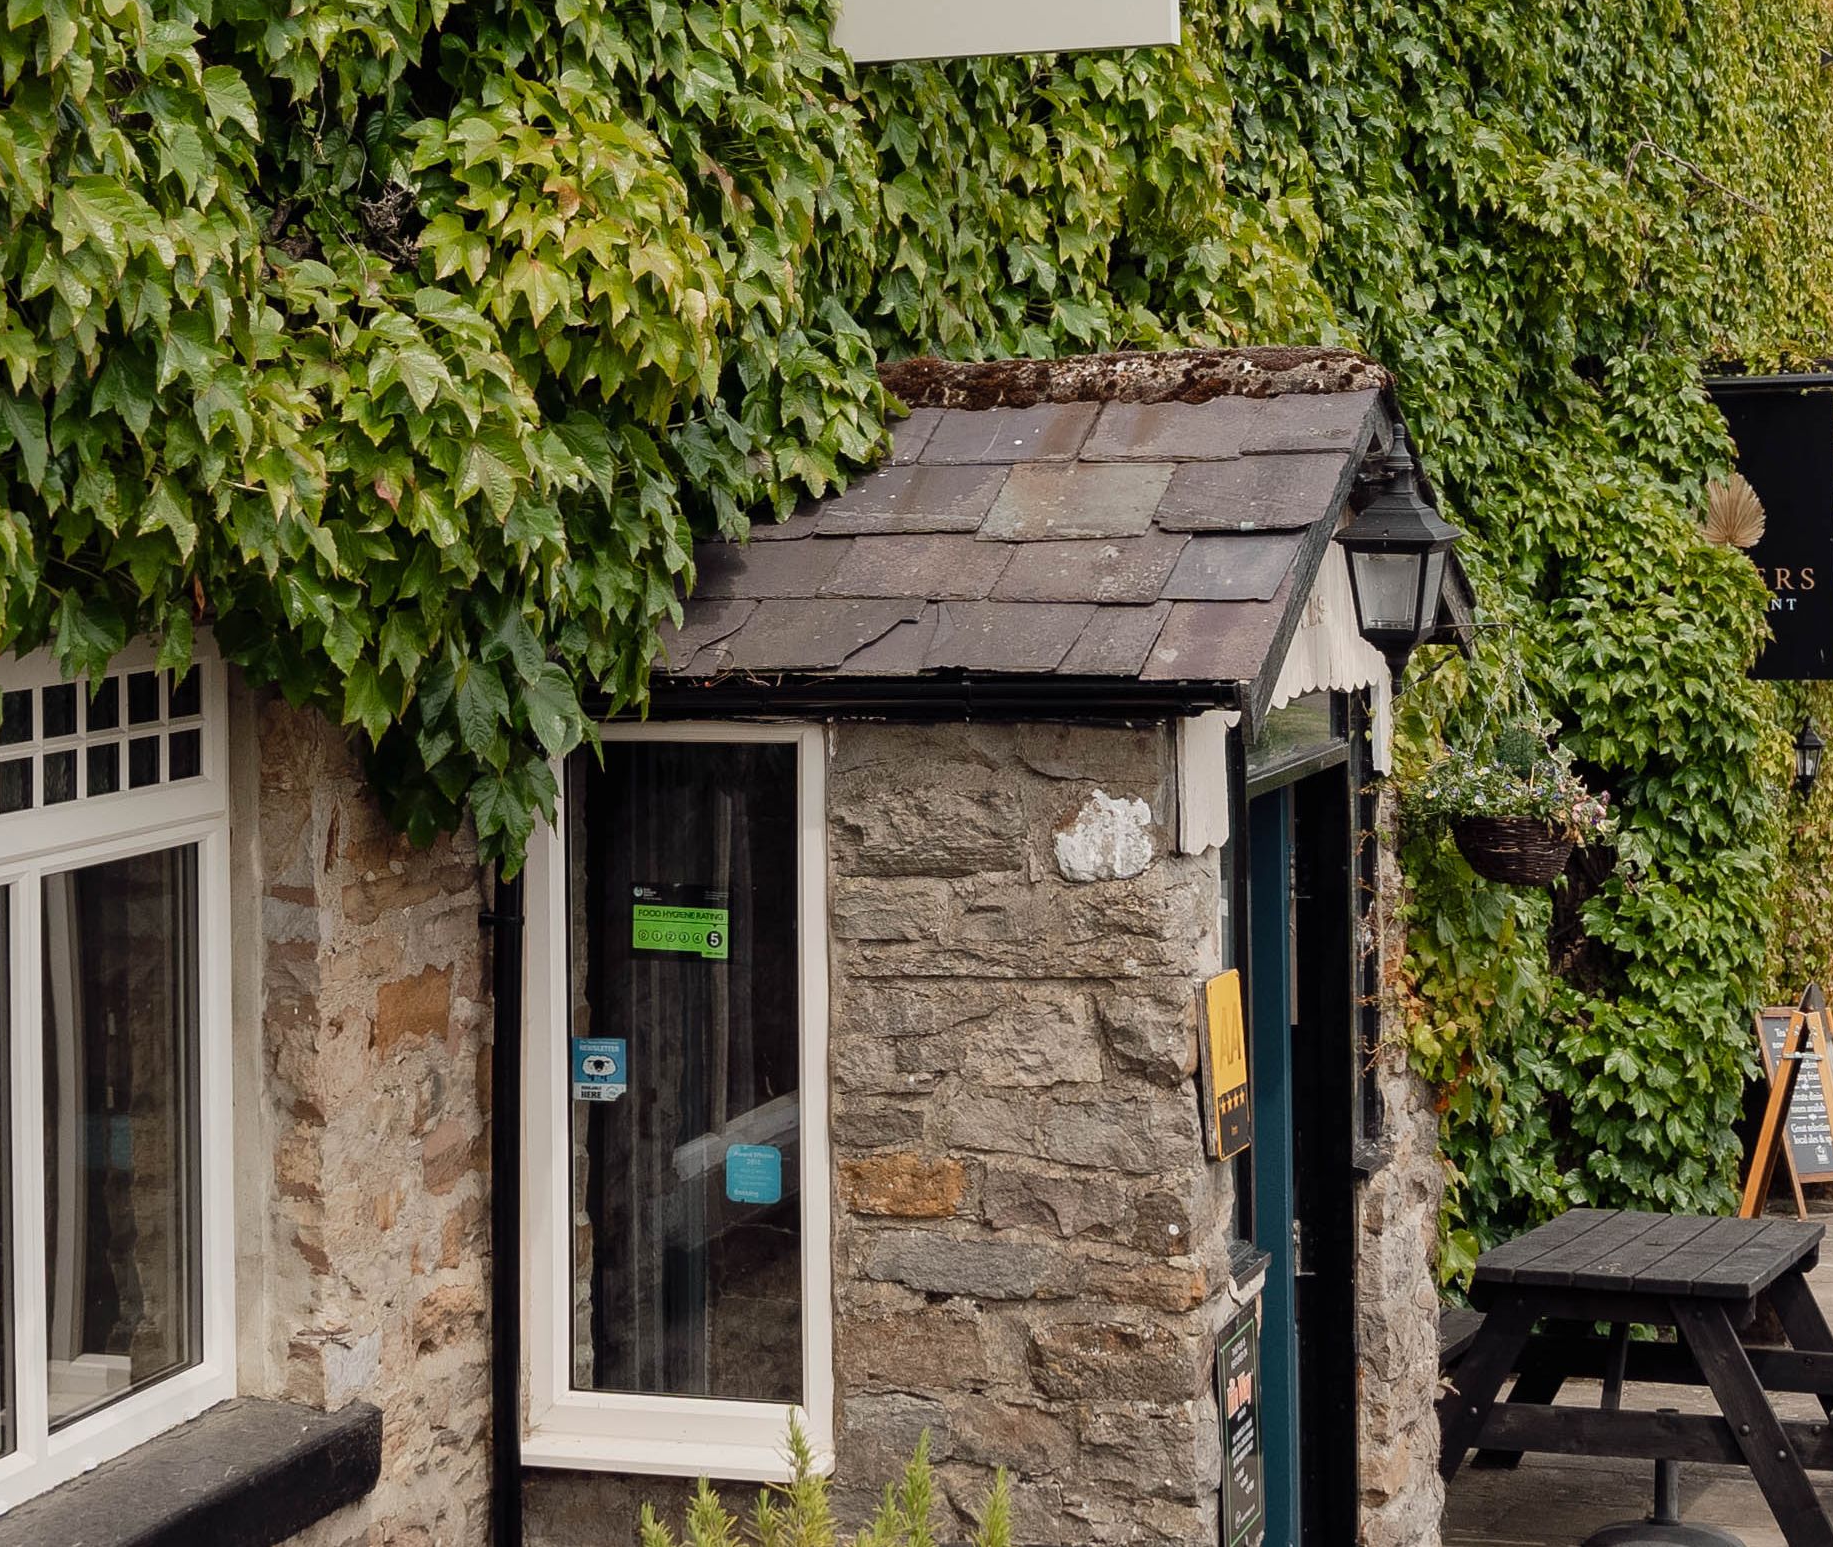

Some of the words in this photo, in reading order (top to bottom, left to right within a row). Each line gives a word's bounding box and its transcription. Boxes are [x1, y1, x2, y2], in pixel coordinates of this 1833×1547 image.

[638, 909, 662, 917] FOOD
[662, 910, 696, 920] HYGIENE
[696, 912, 724, 921] RATING
[710, 933, 719, 946] 5
[579, 1044, 620, 1052] NEWSLETTER
[581, 1091, 602, 1099] HERE
